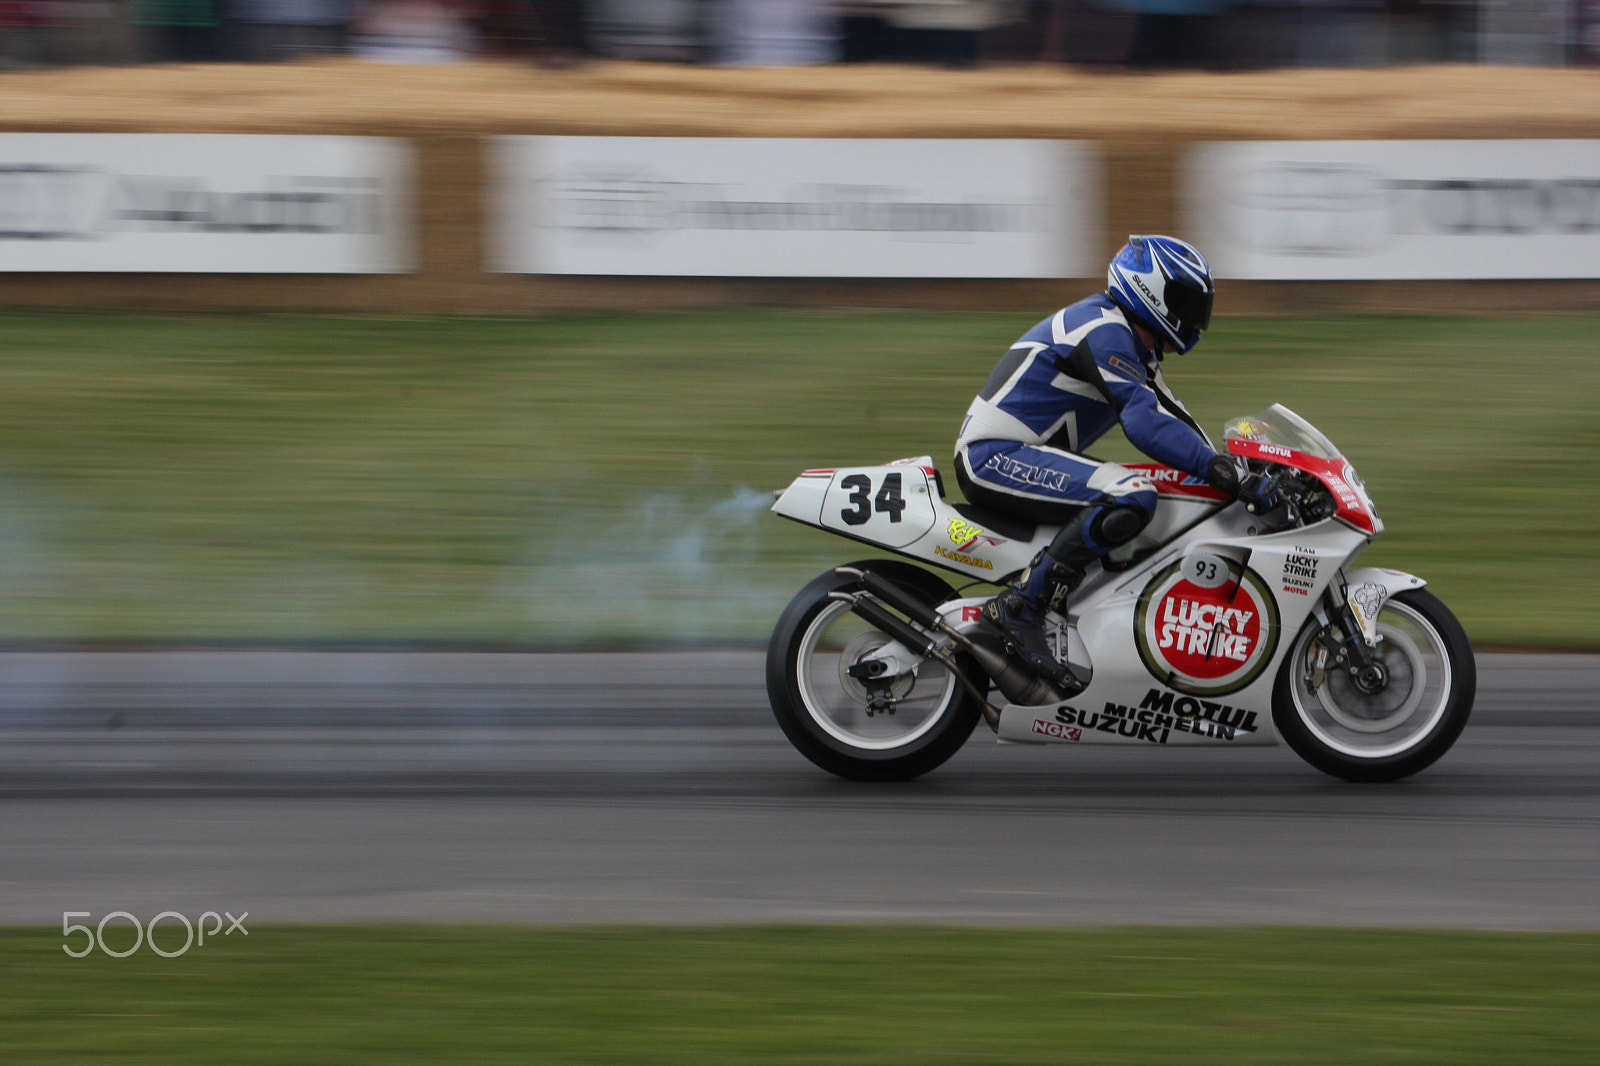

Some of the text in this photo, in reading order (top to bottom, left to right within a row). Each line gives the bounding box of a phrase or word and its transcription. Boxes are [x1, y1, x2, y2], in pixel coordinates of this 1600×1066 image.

[1132, 274, 1161, 307] SUZUKI
[1259, 443, 1292, 458] MOTUL
[985, 453, 1071, 493] SUZUKI
[841, 472, 906, 525] 34
[1285, 553, 1319, 569] LUCKY
[1294, 545, 1316, 555] TEAM
[1195, 560, 1217, 580] 93
[1282, 577, 1314, 589] SUZUKI
[1283, 563, 1317, 579] STRIKE
[1283, 585, 1308, 596] MOTUL
[1163, 596, 1253, 634] LUCKY
[1159, 626, 1252, 662] STRIKE
[1103, 702, 1236, 740] MICHELIN
[1139, 688, 1258, 732] MOTUL
[1033, 721, 1075, 741] NGK
[1055, 706, 1171, 744] SUZUKI
